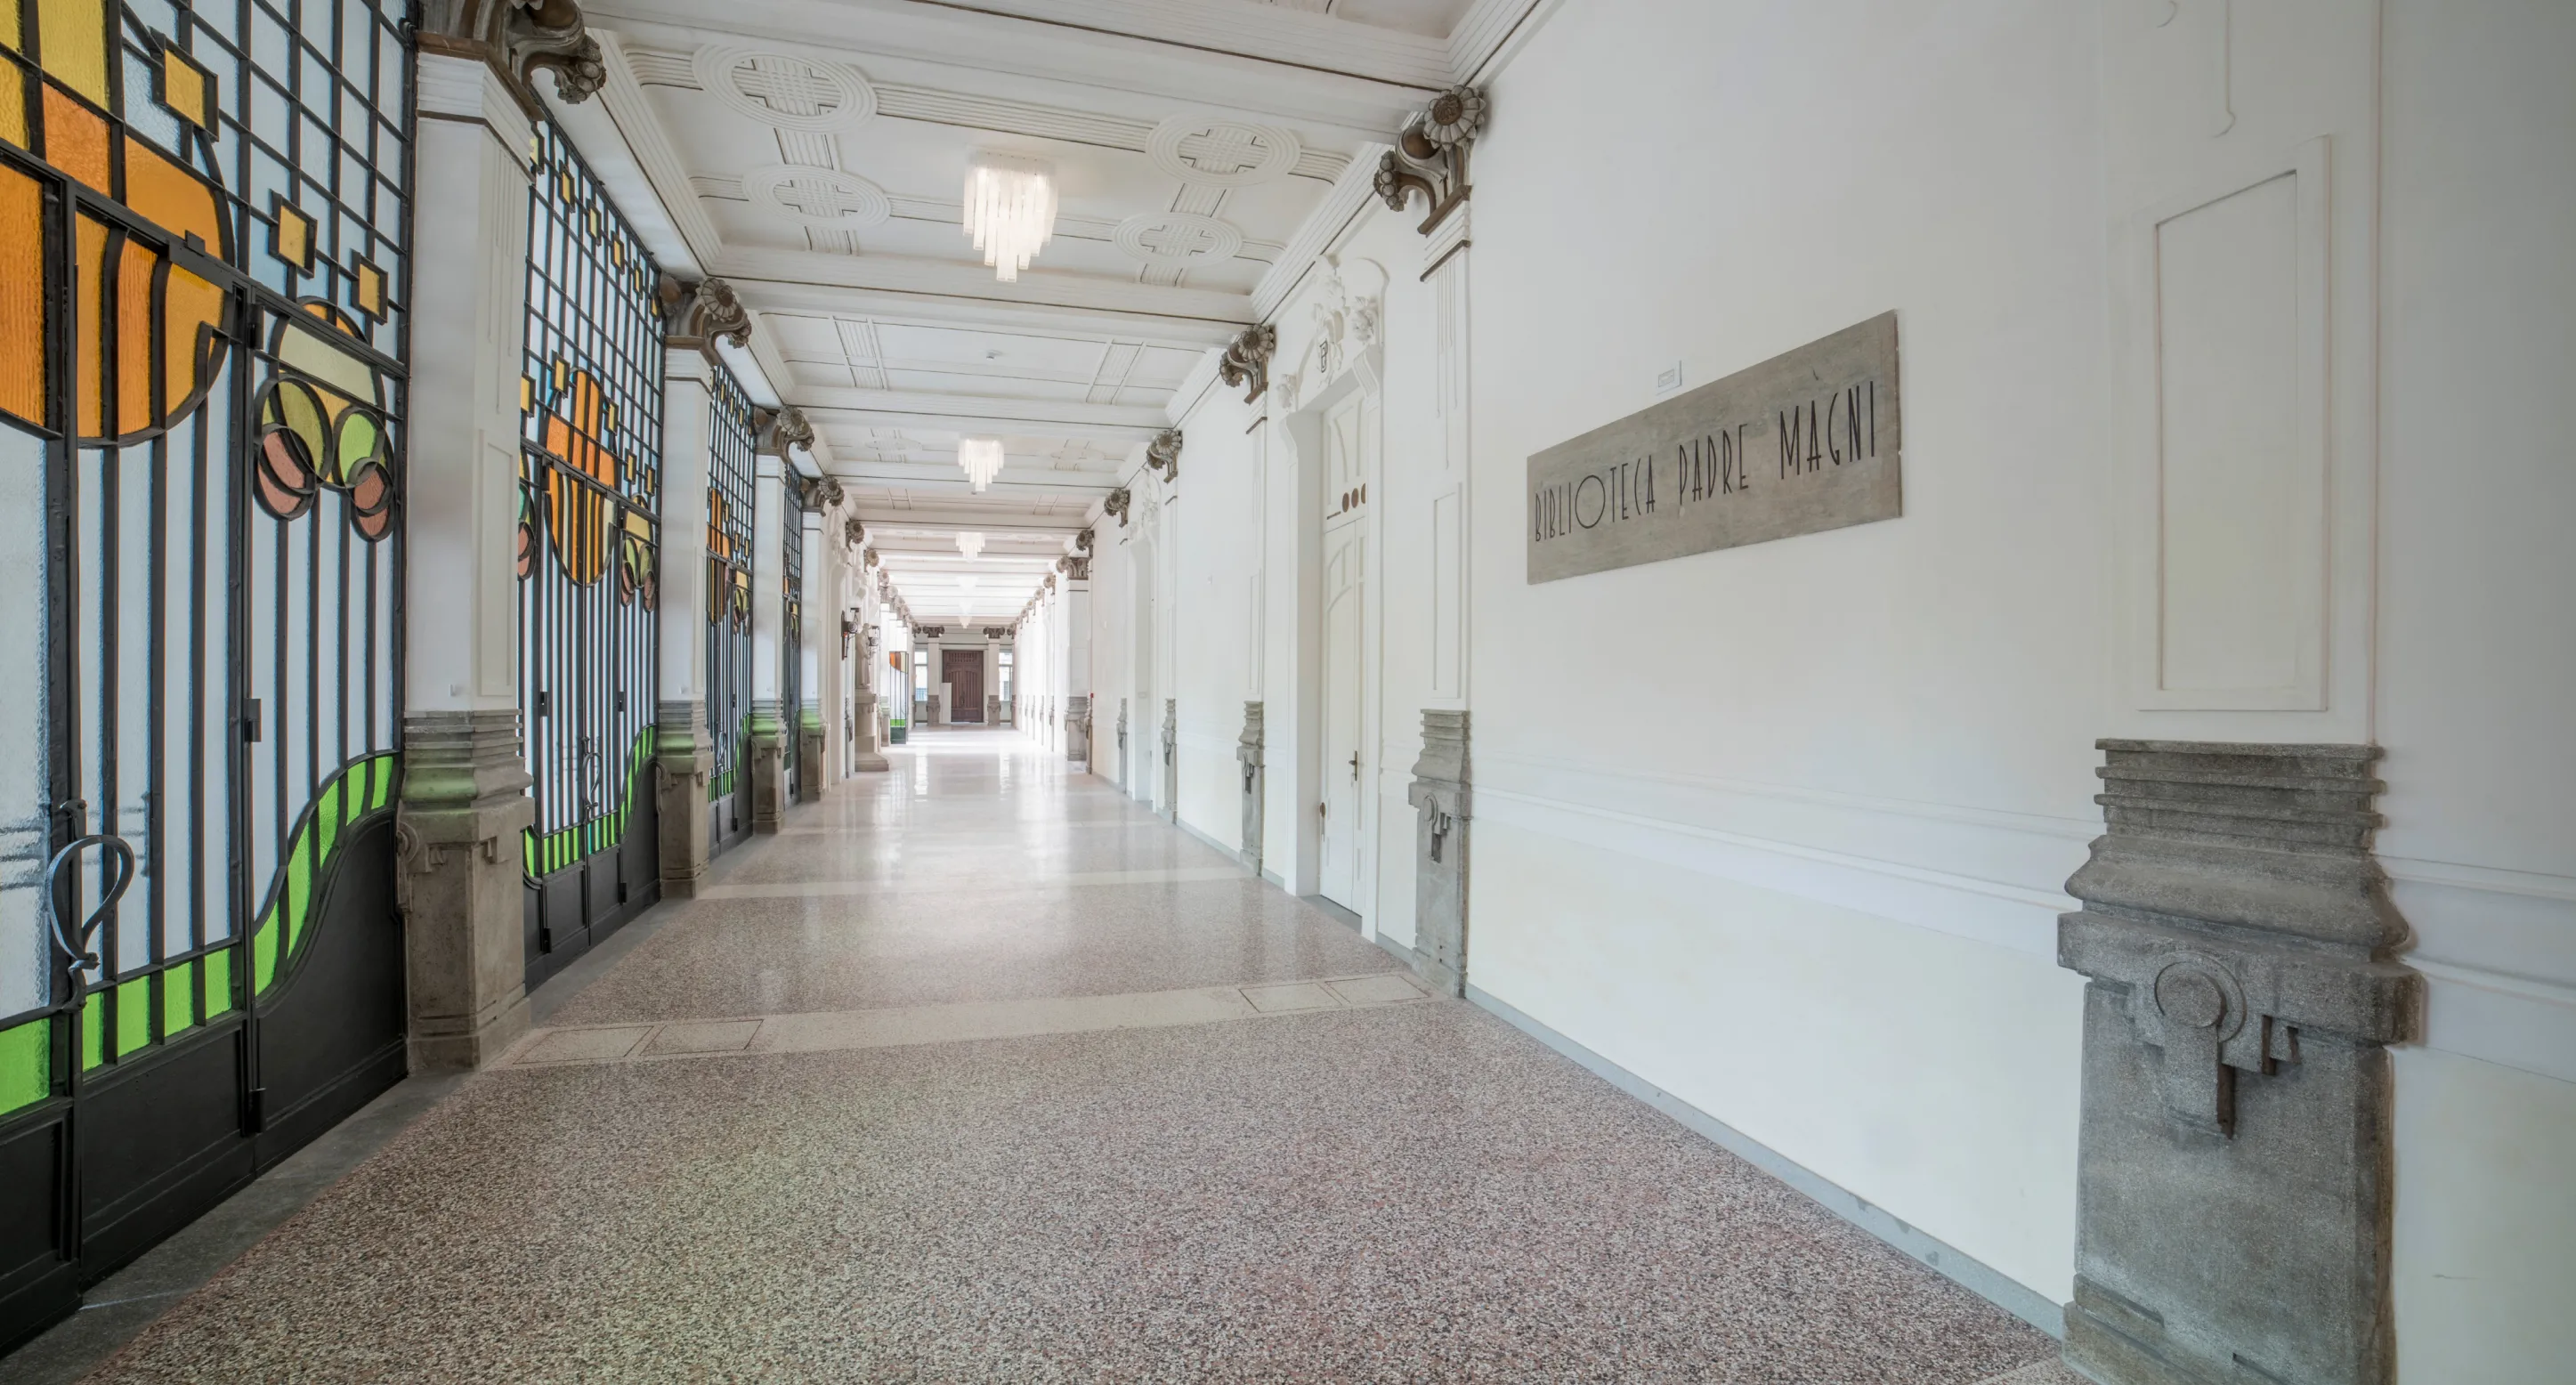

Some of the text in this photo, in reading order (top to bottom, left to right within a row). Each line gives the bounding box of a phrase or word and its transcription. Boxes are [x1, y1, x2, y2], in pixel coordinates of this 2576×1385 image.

[1535, 380, 1875, 542] BIBLIOTECA PADRE MAGNI
